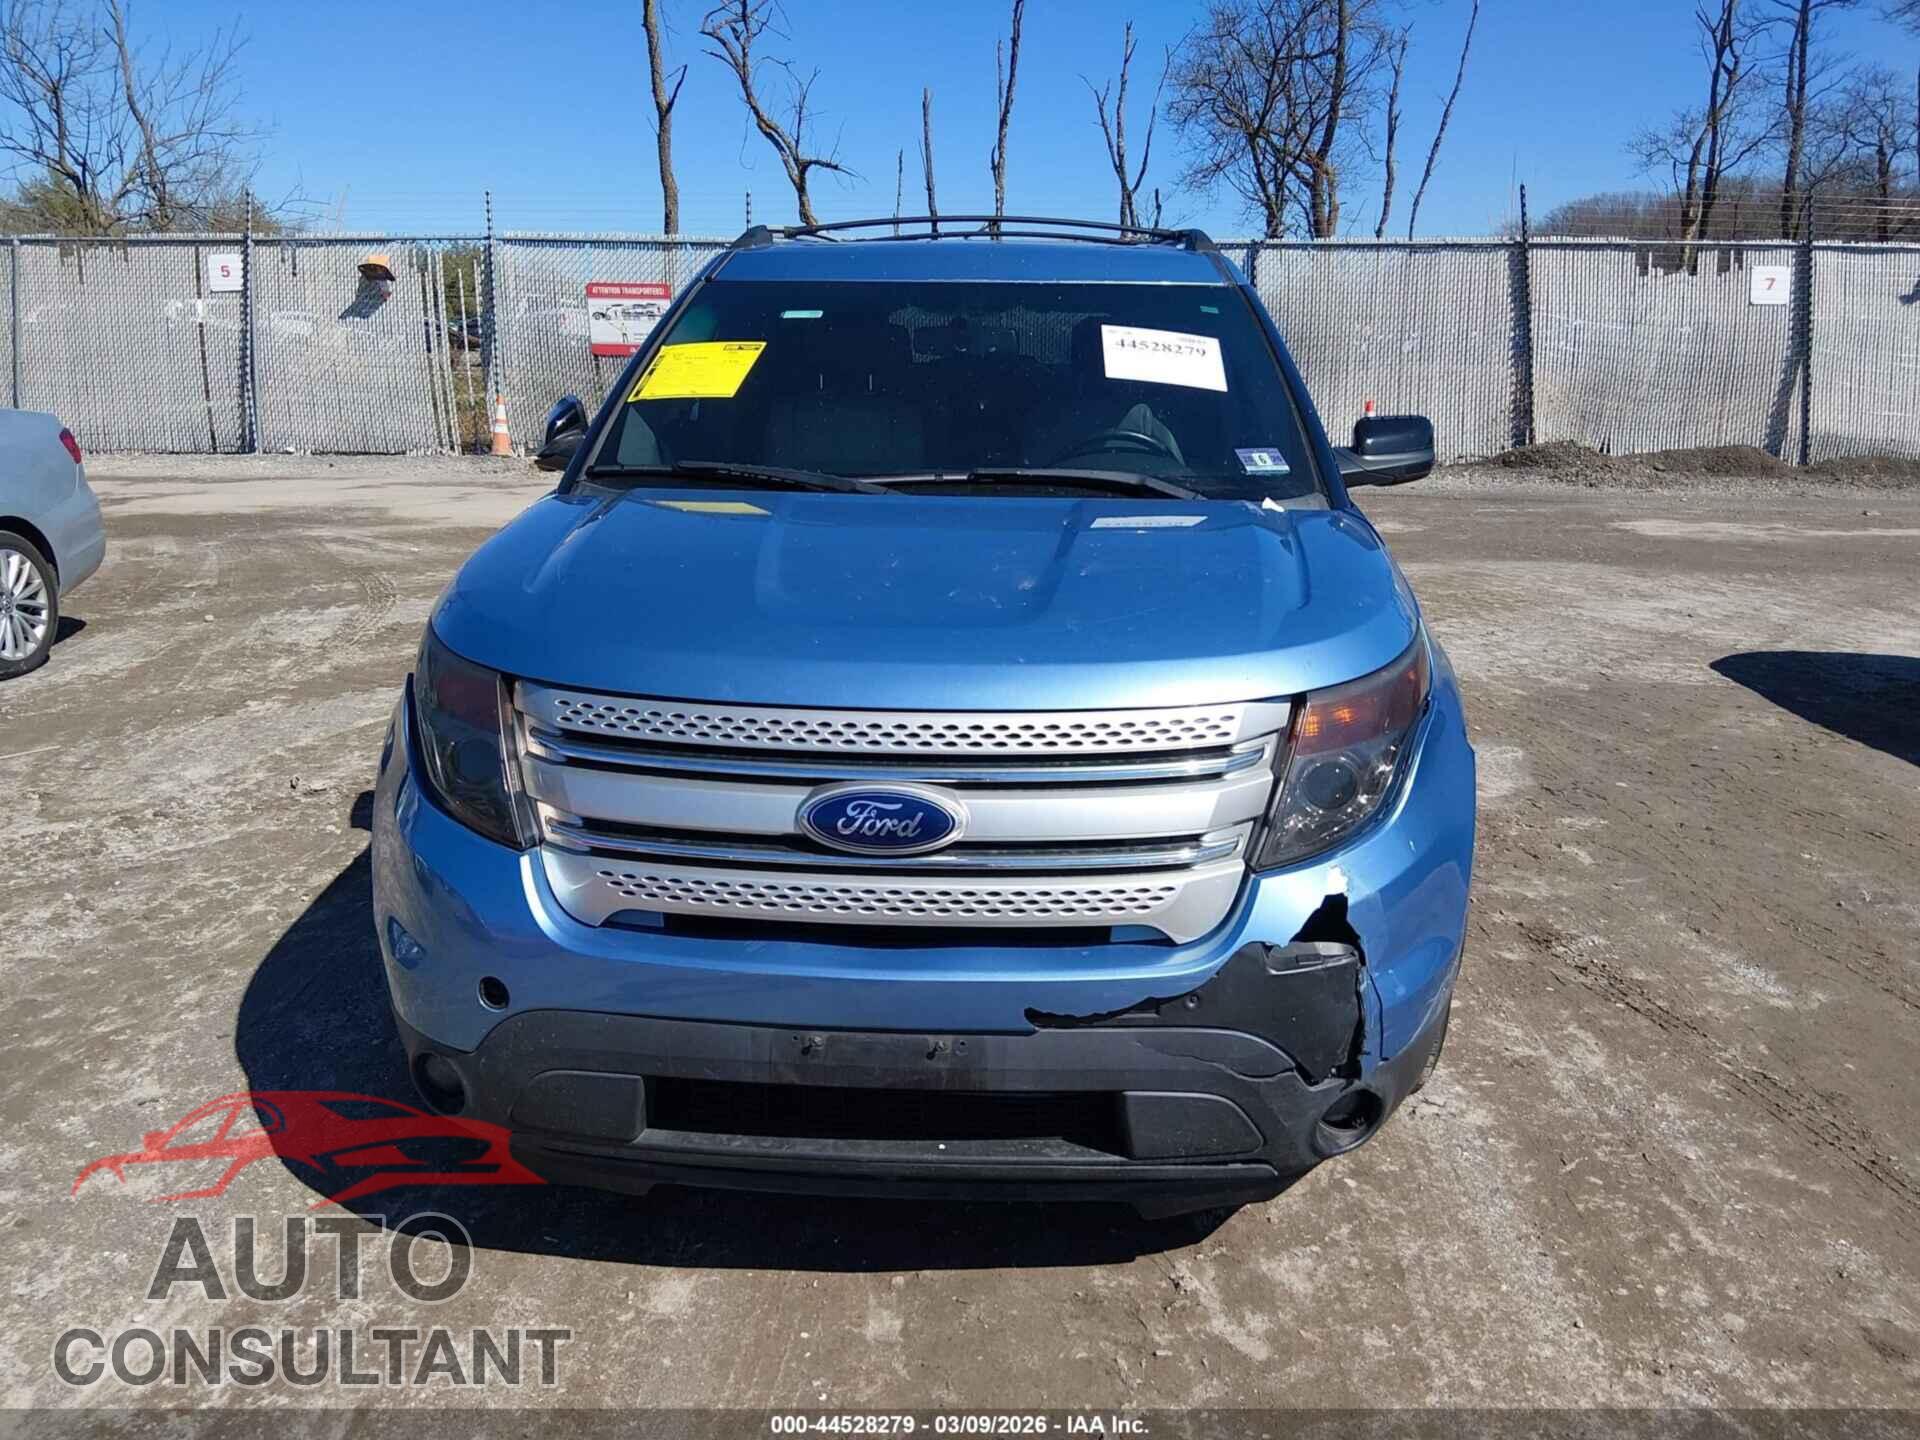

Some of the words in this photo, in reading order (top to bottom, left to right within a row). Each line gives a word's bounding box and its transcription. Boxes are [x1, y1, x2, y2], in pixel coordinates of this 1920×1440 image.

[220, 265, 231, 278] 5
[1765, 277, 1776, 290] 7
[1115, 338, 1207, 357] 44528279
[836, 800, 923, 837] Ford
